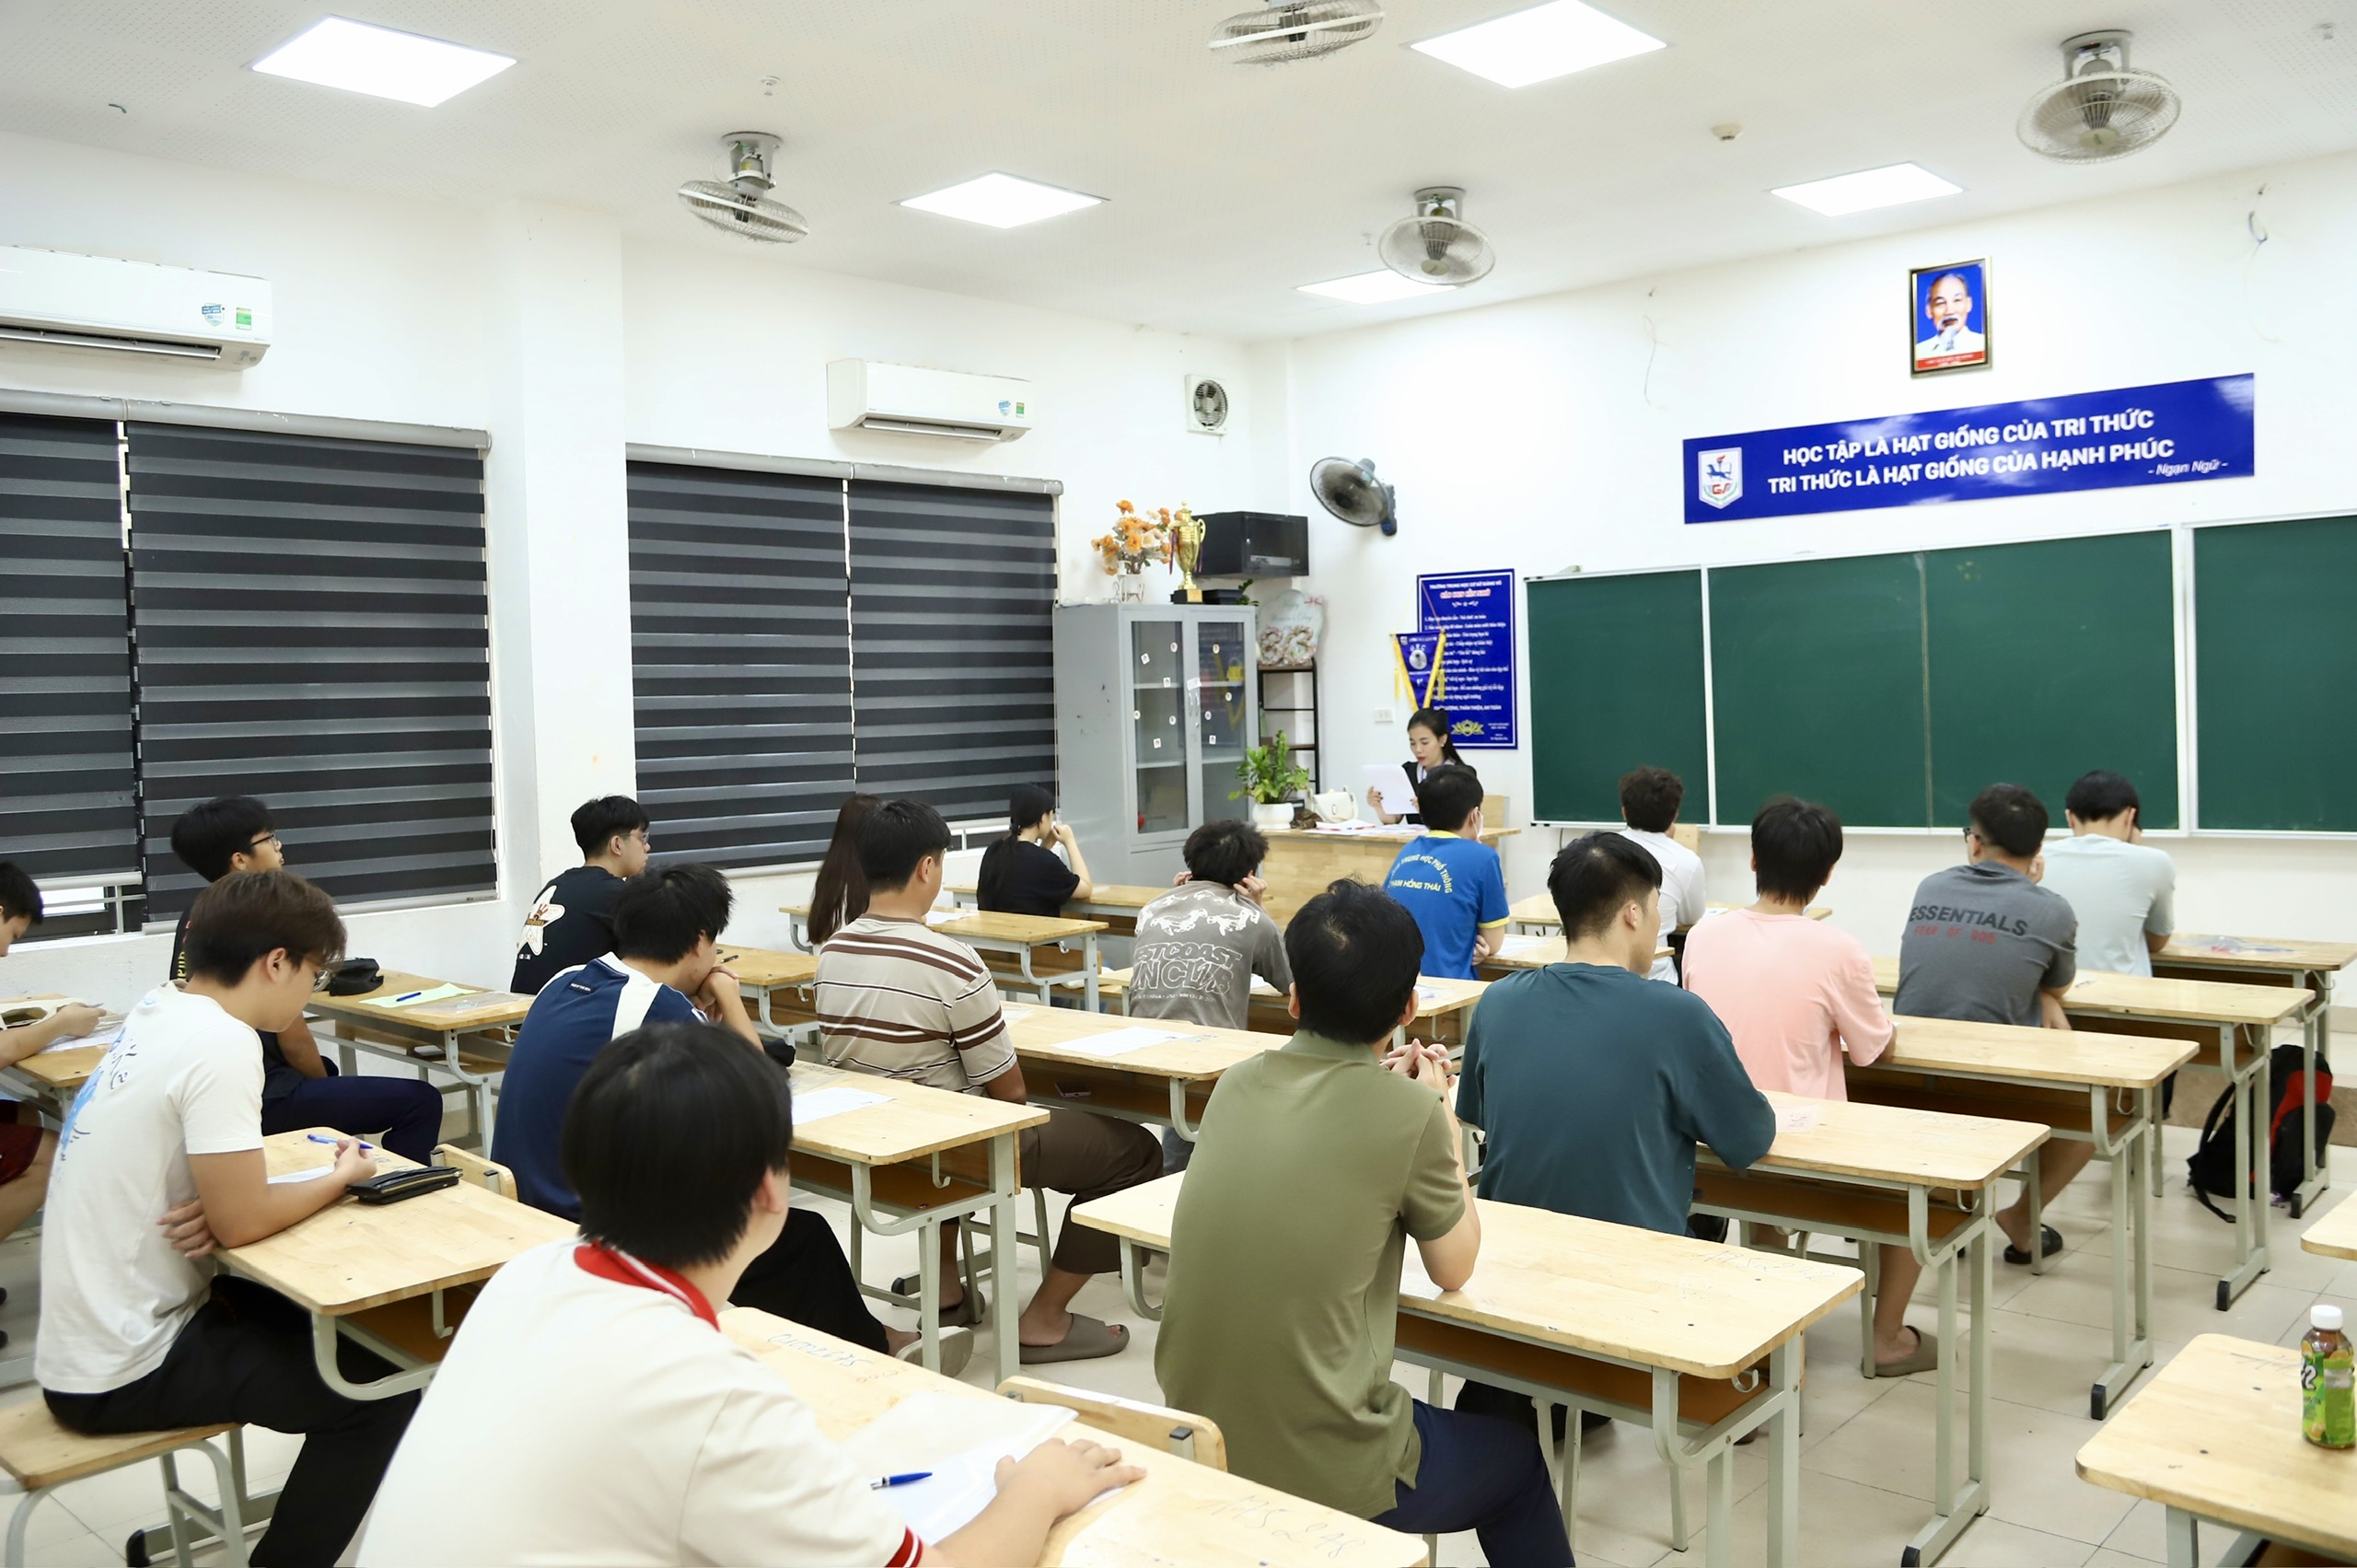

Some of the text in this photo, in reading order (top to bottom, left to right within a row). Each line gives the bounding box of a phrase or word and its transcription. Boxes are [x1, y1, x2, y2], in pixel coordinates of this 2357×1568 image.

[1783, 408, 2154, 467] HỌC TẬP LÀ HẠT GIỐNG CỦA TRI THỨC
[1768, 436, 2176, 494] TRI THỨC LÀ HẠT GIỐNG CỦA HẠNH PHÚC
[2155, 463, 2189, 478] Ngạn
[2191, 459, 2221, 473] Ngữ
[1909, 905, 2028, 936] ESSENTIALS
